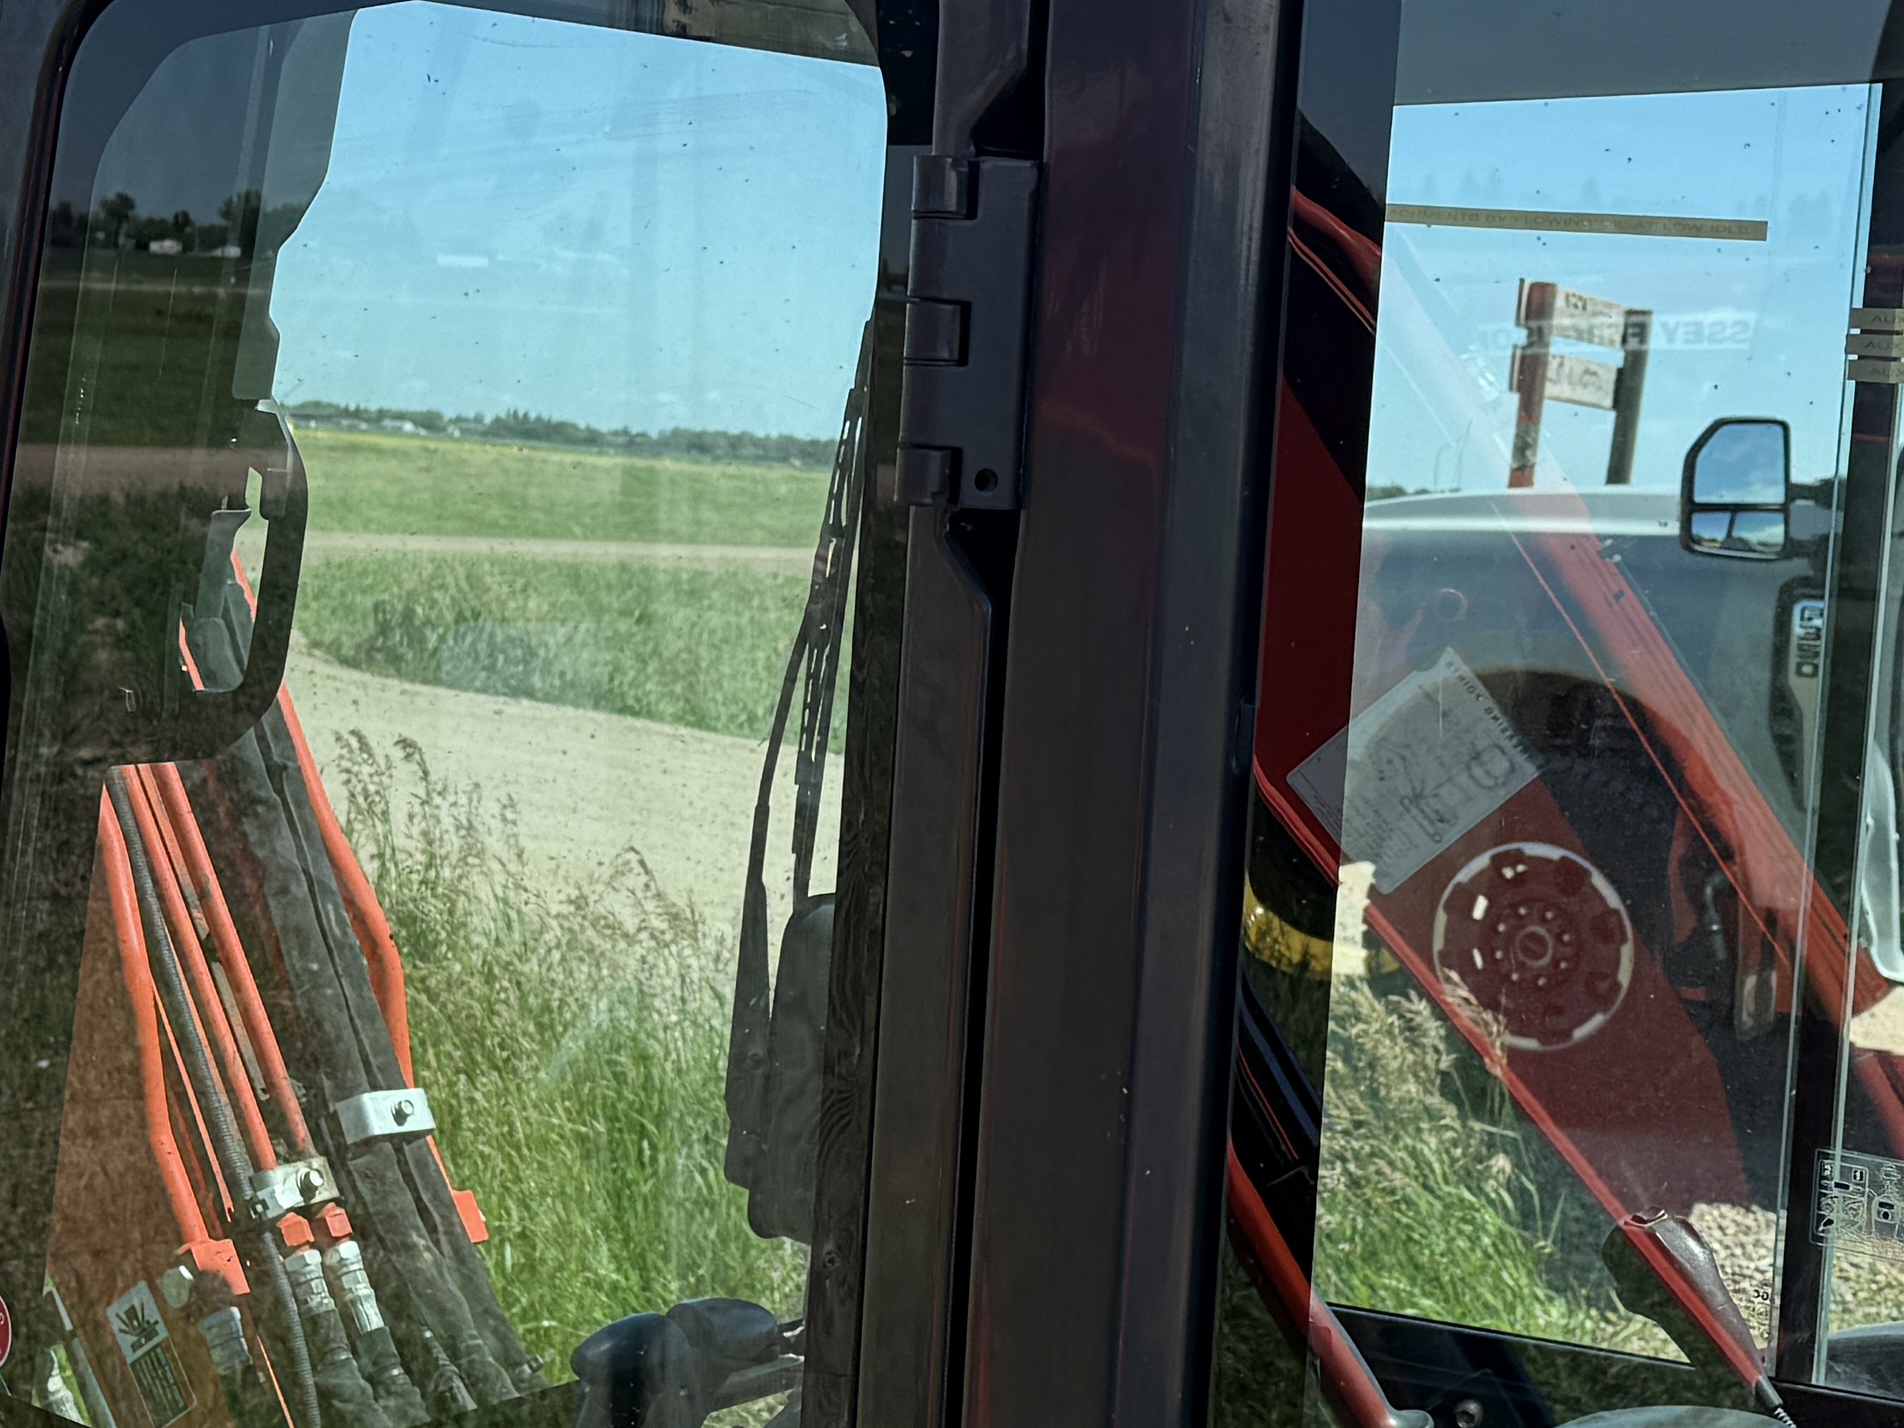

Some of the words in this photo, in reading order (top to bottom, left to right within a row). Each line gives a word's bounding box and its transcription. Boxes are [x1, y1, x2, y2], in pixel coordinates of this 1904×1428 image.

[1662, 223, 1704, 232] LOW
[1710, 225, 1749, 235] IDLE
[1863, 340, 1902, 351] AUX
